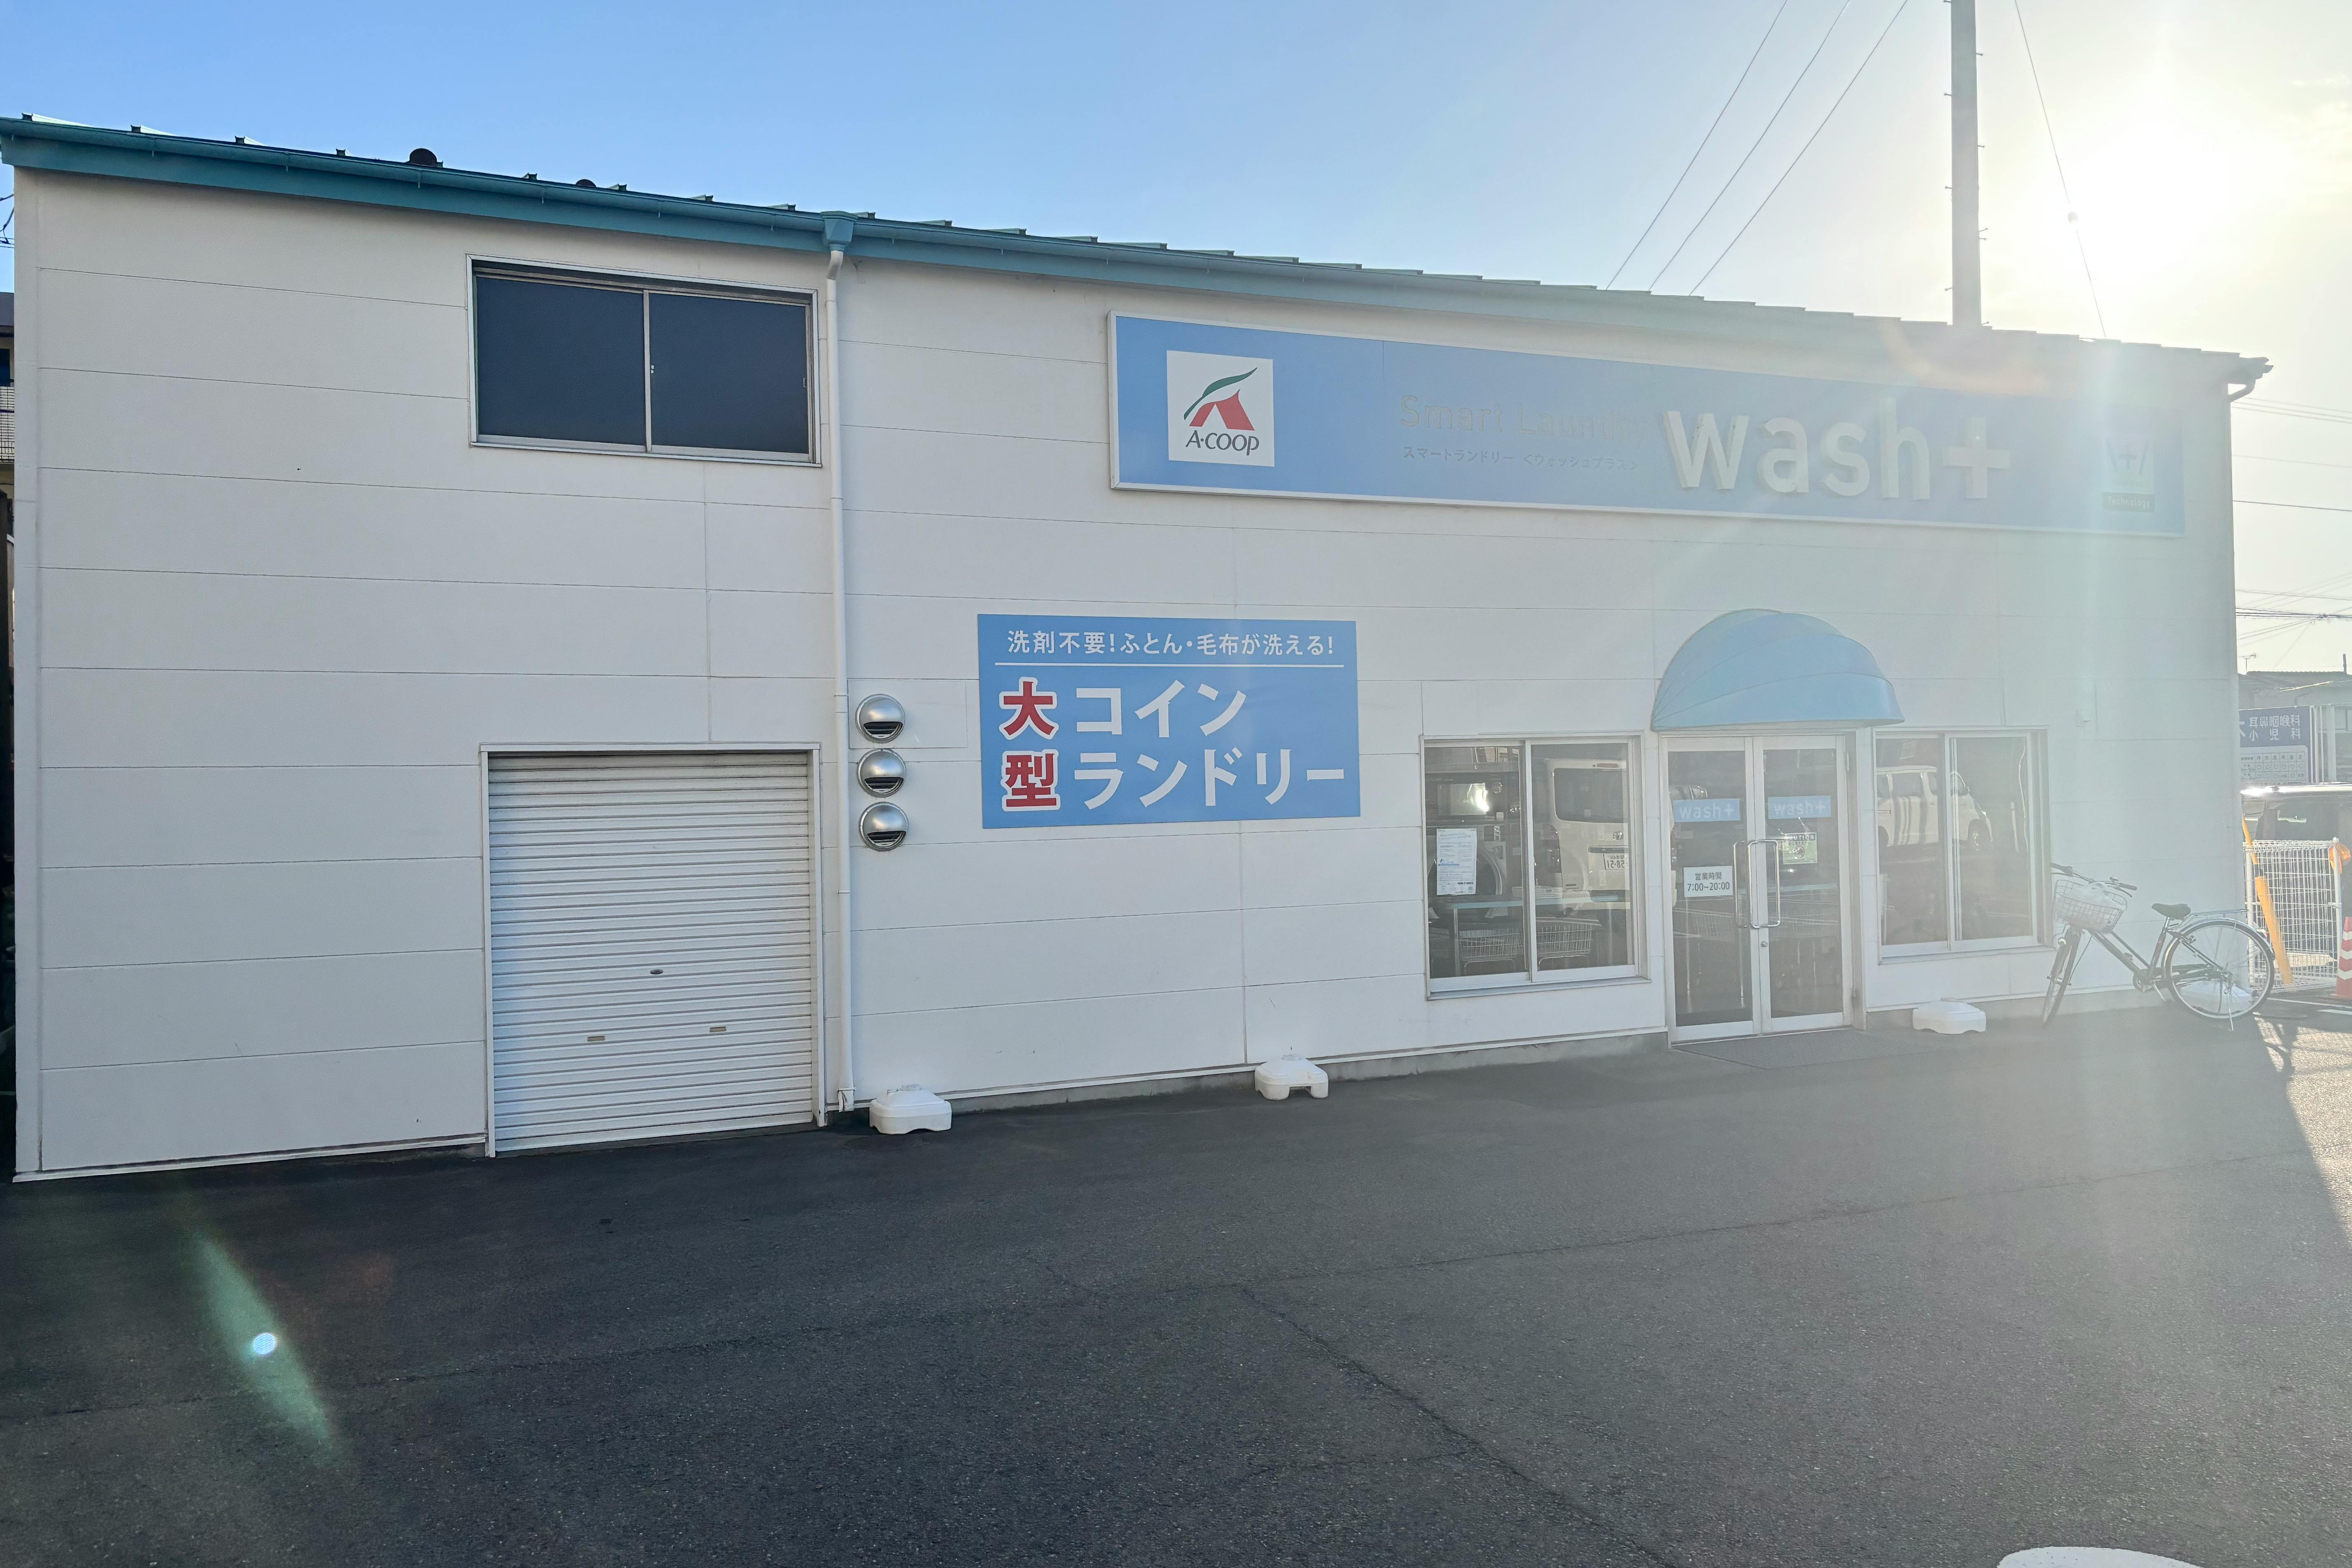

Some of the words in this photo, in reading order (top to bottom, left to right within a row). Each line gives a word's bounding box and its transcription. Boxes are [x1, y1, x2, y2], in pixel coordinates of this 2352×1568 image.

[1400, 394, 1503, 432] Smart
[1518, 402, 1647, 449] Laundry
[1403, 446, 1514, 464] スマートランドリー
[2108, 496, 2151, 509] Technology
[2249, 714, 2300, 728] 耳鼻咽喉科
[1695, 872, 1722, 880] 営業時間
